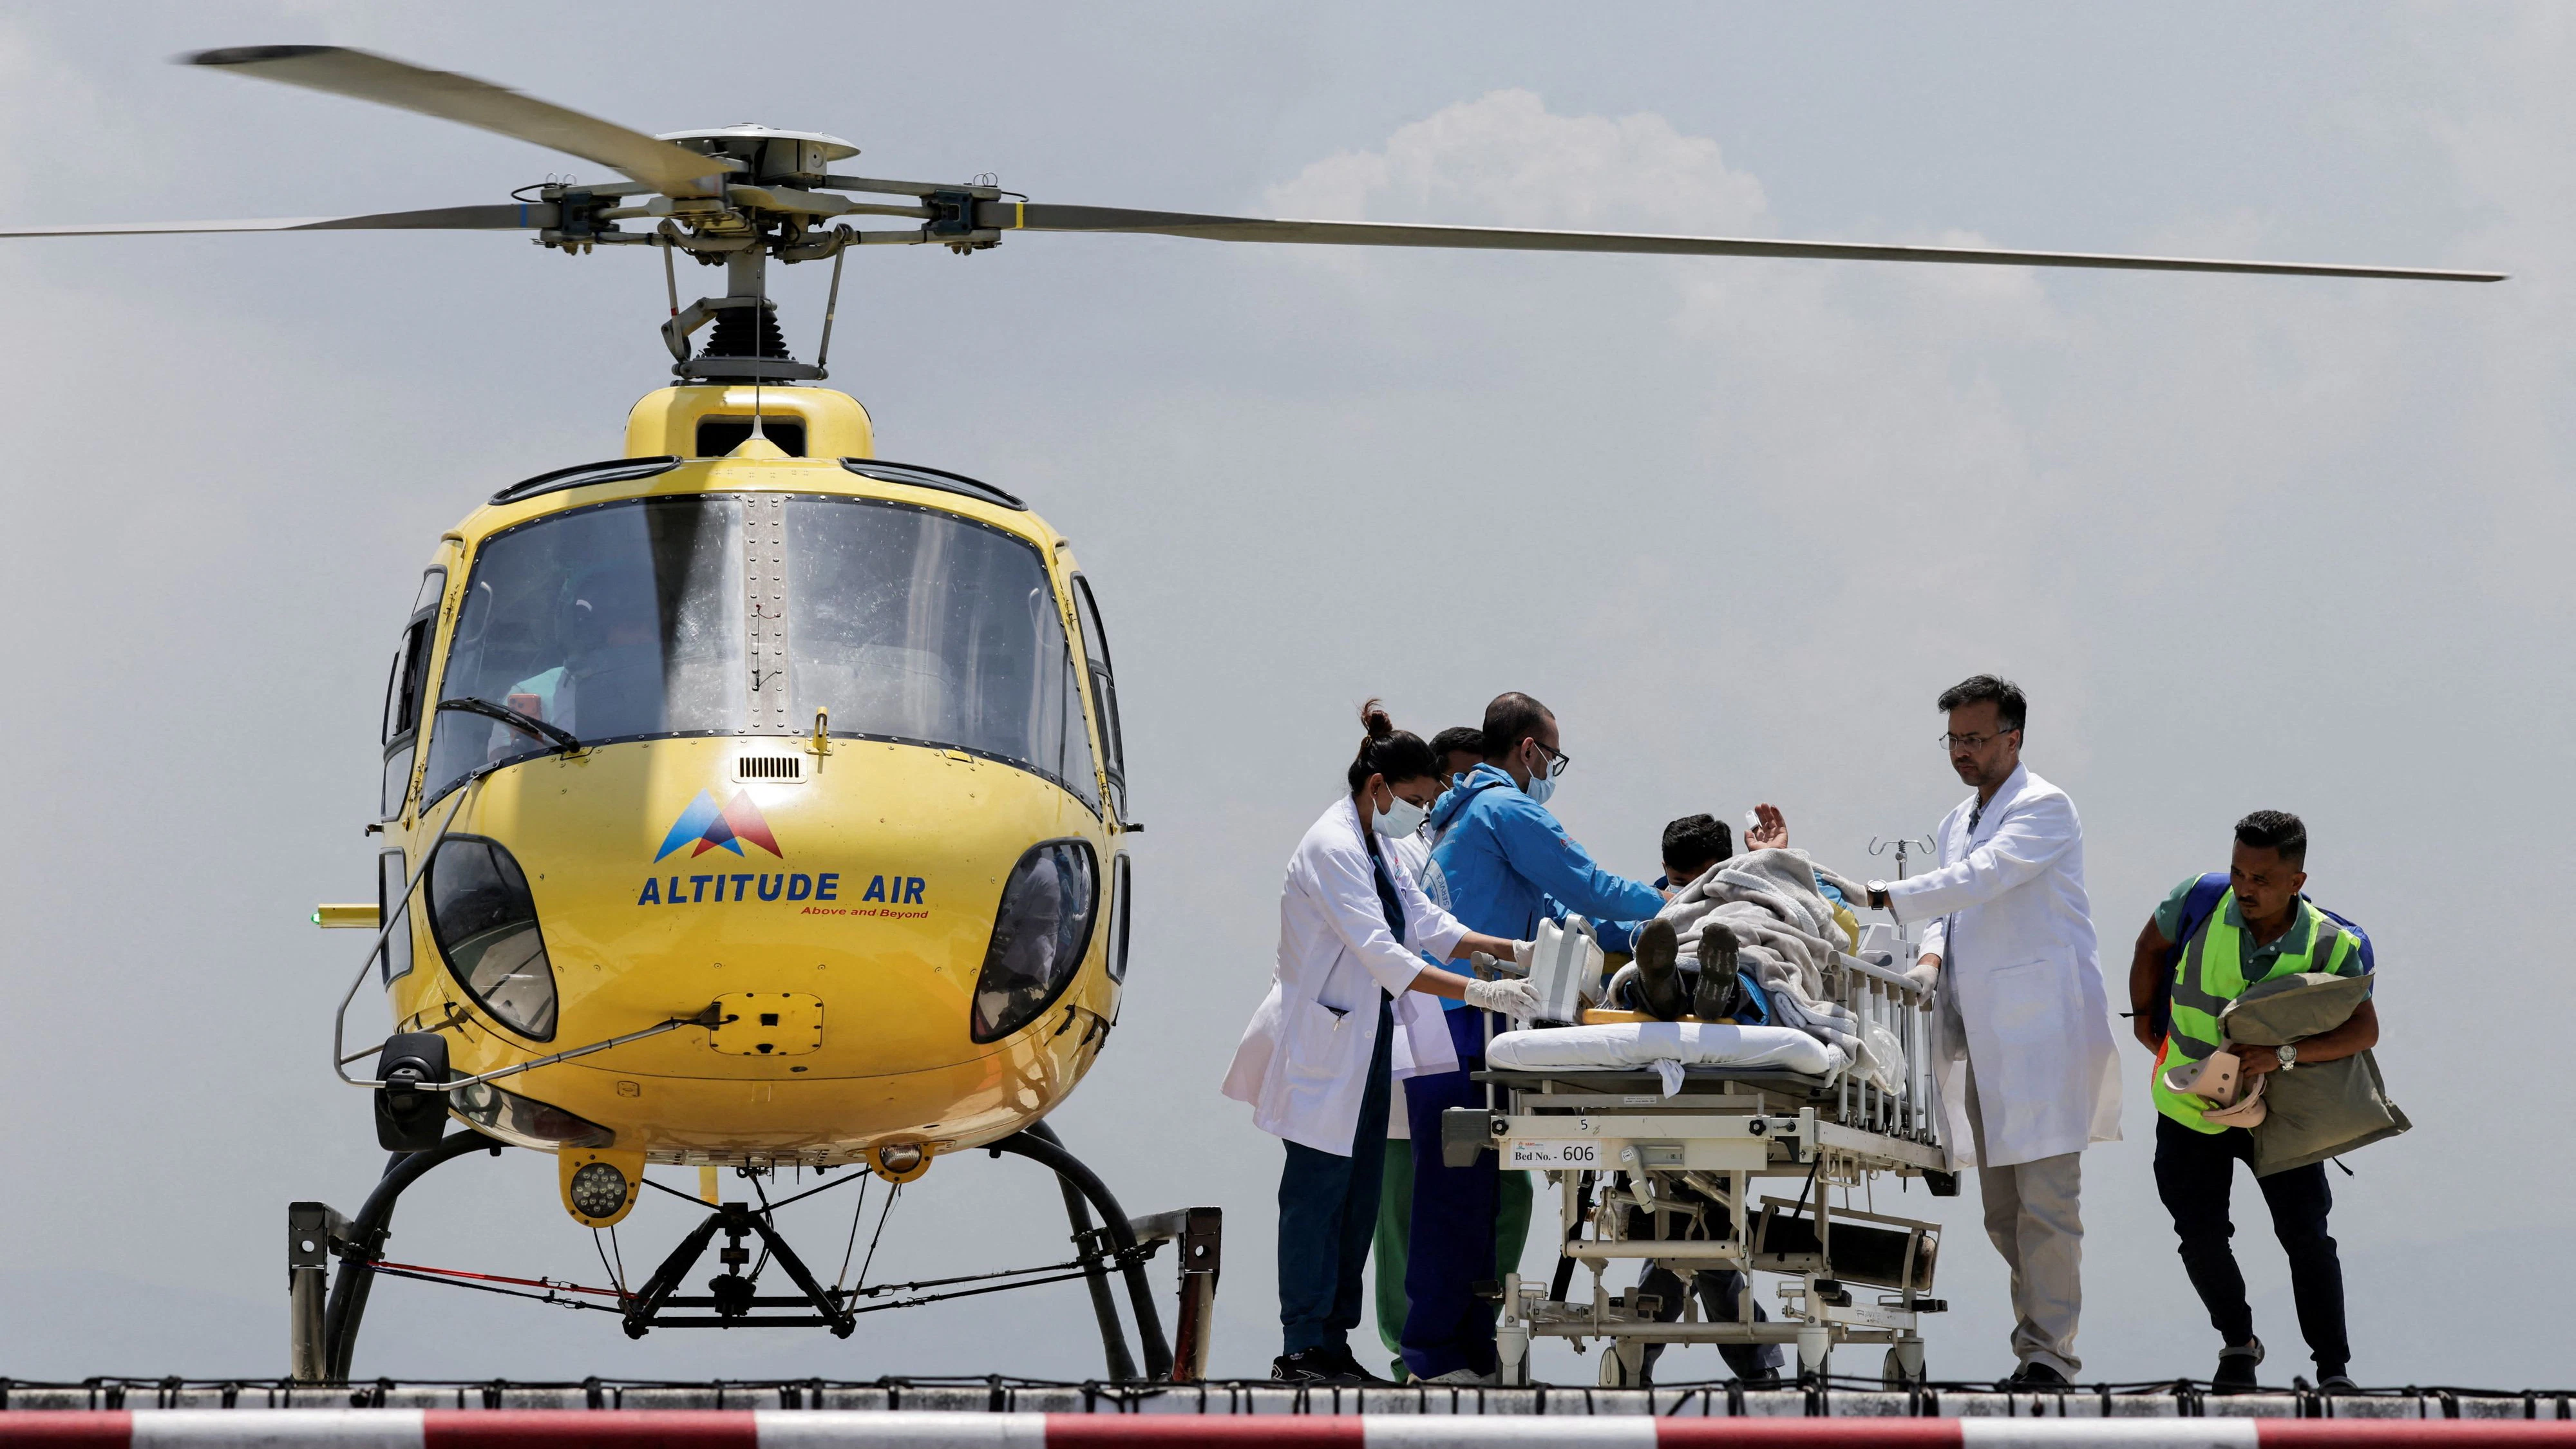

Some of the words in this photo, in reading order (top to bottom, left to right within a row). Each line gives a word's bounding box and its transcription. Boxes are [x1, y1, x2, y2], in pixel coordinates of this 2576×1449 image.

[638, 873, 839, 905] ALTITUDE
[862, 875, 925, 905] AIR
[1436, 873, 1449, 906] SERVICE
[801, 907, 846, 915] Above
[880, 909, 929, 920] Beyond
[1581, 1119, 1588, 1130] 5
[1515, 1152, 1532, 1160] Bed
[1535, 1152, 1551, 1160] No.
[1563, 1146, 1594, 1161] 606
